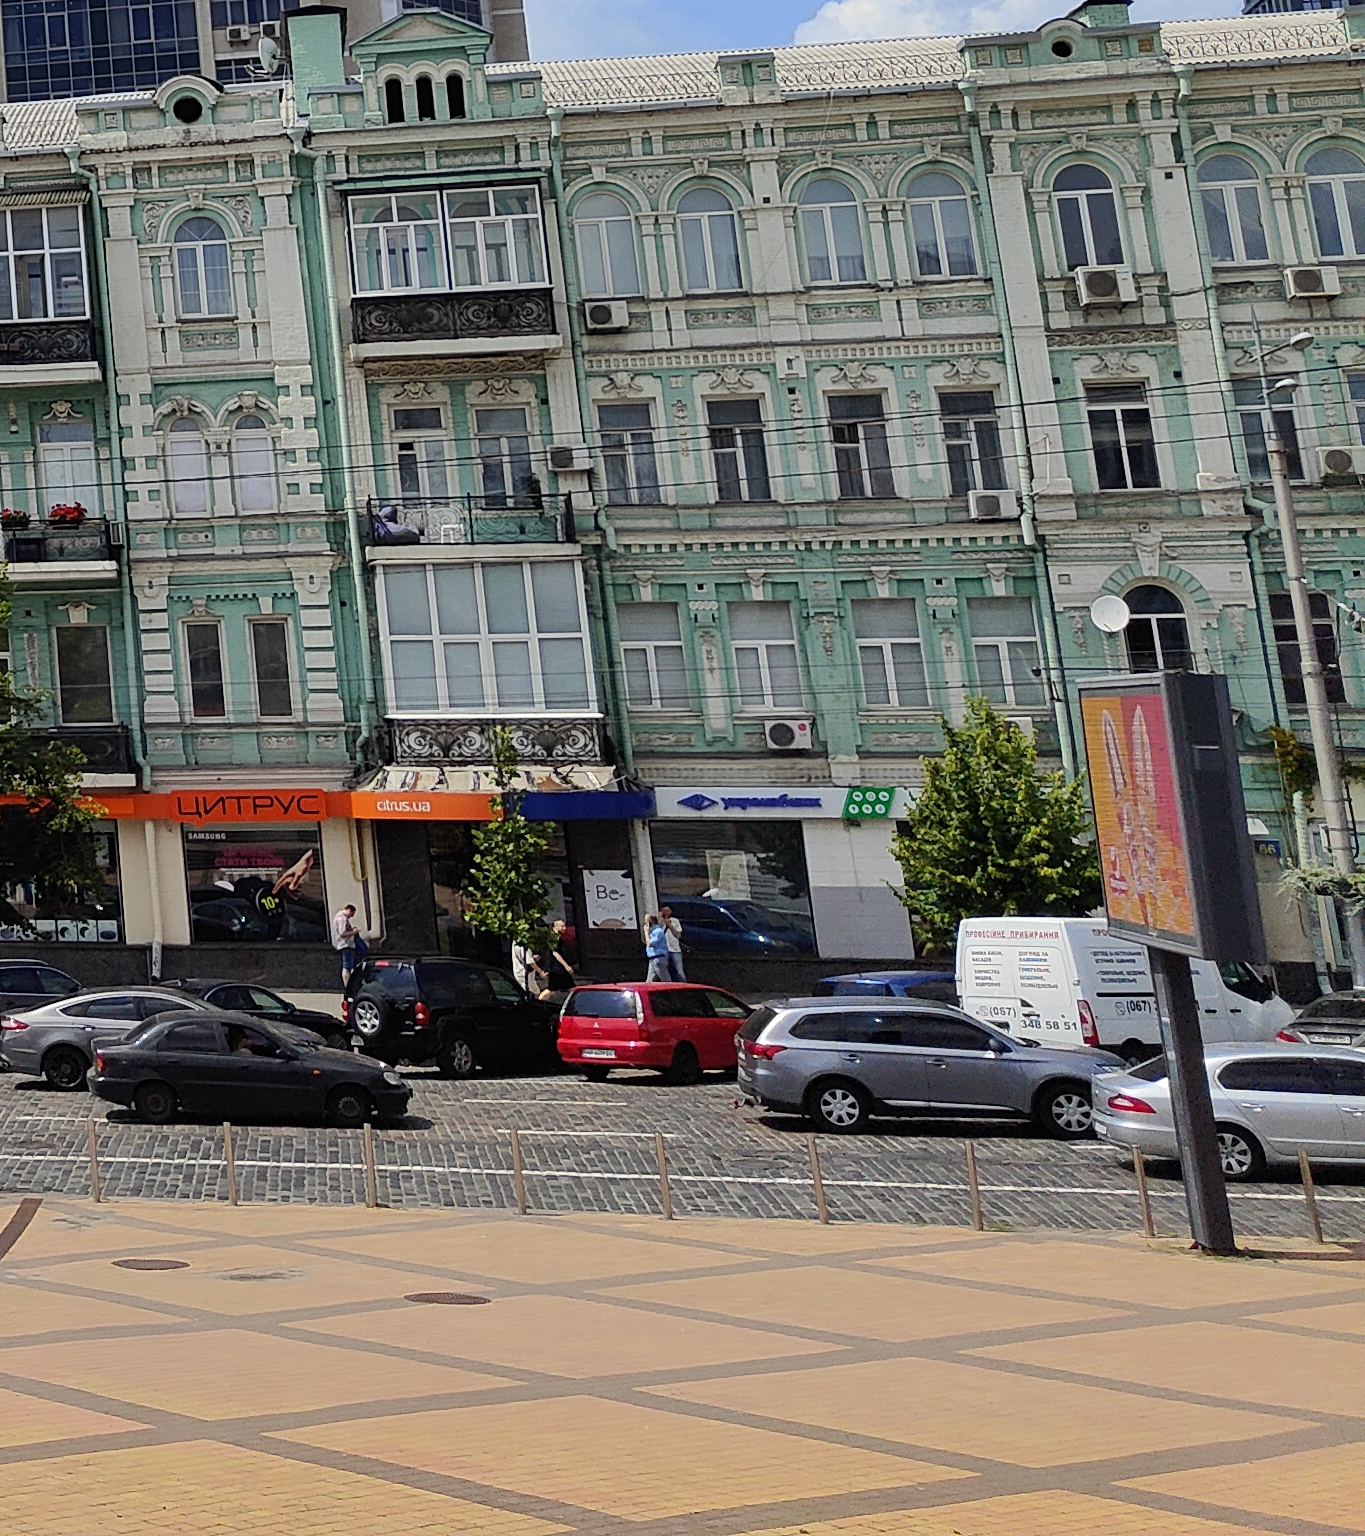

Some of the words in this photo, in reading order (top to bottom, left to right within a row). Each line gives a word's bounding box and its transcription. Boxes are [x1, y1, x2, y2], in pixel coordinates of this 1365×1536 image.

[177, 795, 320, 819] ЦИТРУС
[376, 799, 431, 813] citrus.ua
[188, 832, 227, 840] SAMSUNG
[1010, 931, 1059, 939] ПРИБИРАННЯ
[1126, 1000, 1152, 1014] (067)
[1020, 1019, 1042, 1030] 348
[1045, 1020, 1060, 1030] 58
[1063, 1021, 1078, 1031] 51
